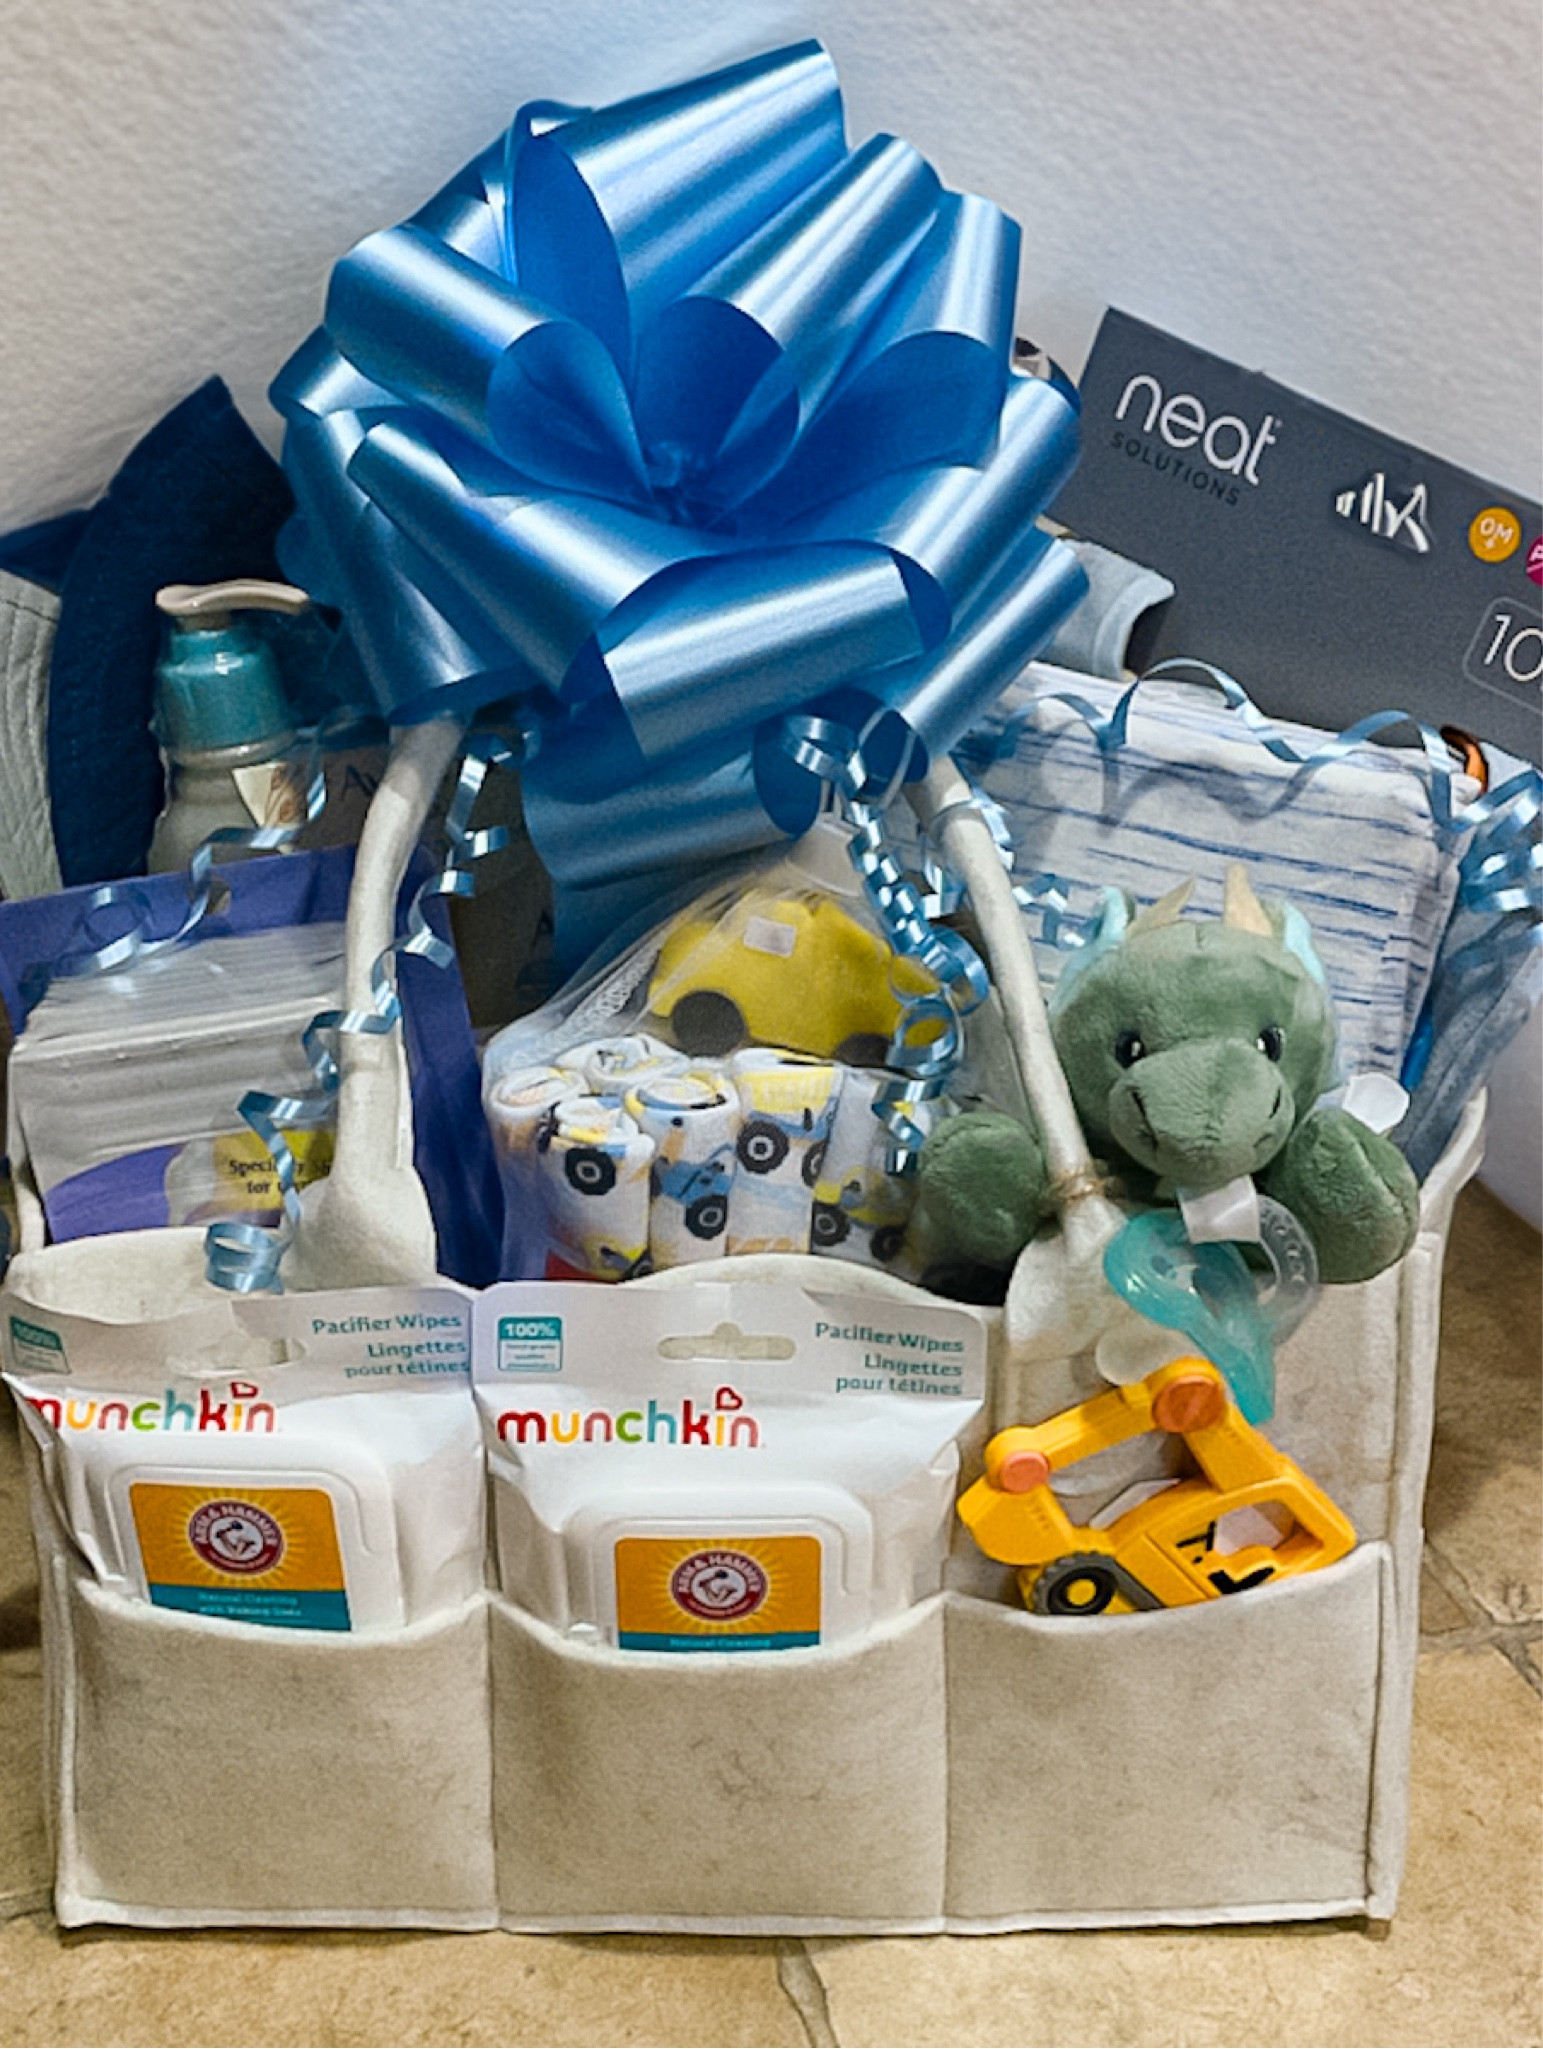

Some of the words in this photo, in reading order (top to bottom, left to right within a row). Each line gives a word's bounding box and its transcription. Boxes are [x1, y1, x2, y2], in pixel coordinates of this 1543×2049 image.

[1115, 374, 1276, 486] neat
[1110, 431, 1241, 506] SOLUTIONS
[311, 1316, 391, 1335] Pacifier
[395, 1313, 462, 1331] Wipes
[504, 1322, 557, 1338] 100%
[815, 1322, 895, 1345] Pacifier
[899, 1332, 964, 1353] Wipes
[367, 1341, 467, 1359] Lingettes
[344, 1365, 392, 1378] pour
[396, 1359, 470, 1375] tétines
[864, 1354, 962, 1376] Lingettes
[836, 1376, 883, 1393] pour
[888, 1377, 962, 1396] tétines
[496, 1386, 759, 1448] munchkin
